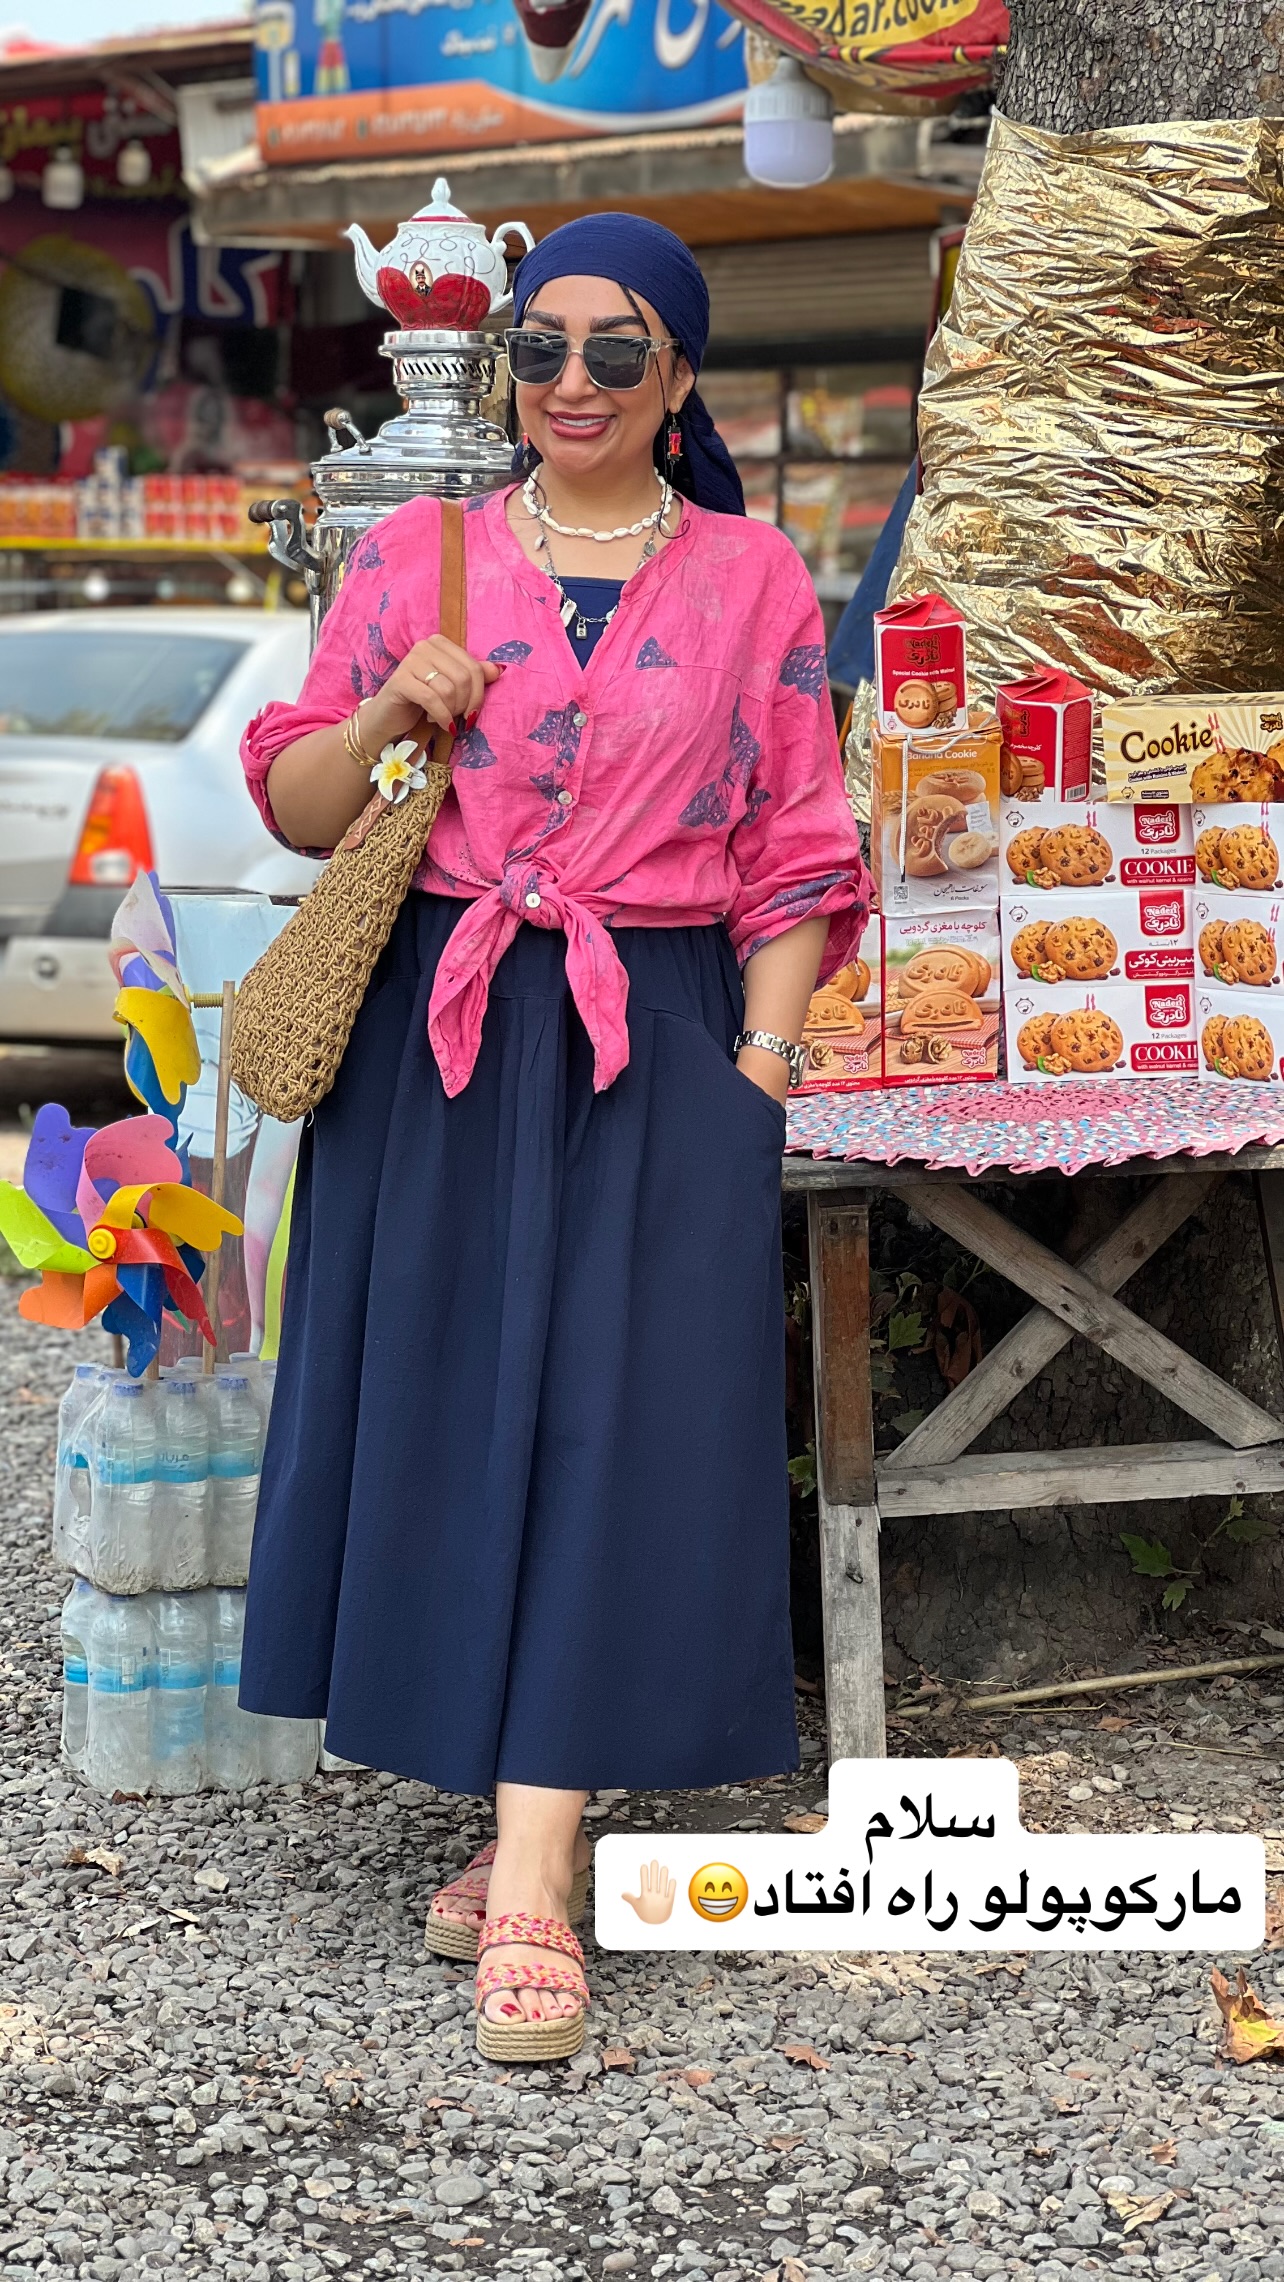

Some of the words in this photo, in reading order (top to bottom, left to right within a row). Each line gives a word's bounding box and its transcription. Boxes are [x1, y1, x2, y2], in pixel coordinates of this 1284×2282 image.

[898, 699, 930, 709] نادری
[1120, 721, 1213, 763] Cookie
[944, 749, 978, 759] Cookie
[1141, 811, 1173, 825] Naderi
[1141, 825, 1175, 840] نادری
[1125, 859, 1195, 875] COOKIE
[1146, 903, 1178, 917] Naderi
[900, 920, 930, 934] گردویی
[930, 922, 953, 933] مغزی
[953, 922, 960, 933] با
[961, 921, 987, 933] کلوچه
[1146, 917, 1179, 932] نادری
[1129, 953, 1158, 968] کوکی
[1151, 995, 1184, 1008] Naderi
[1151, 1010, 1185, 1025] نادری
